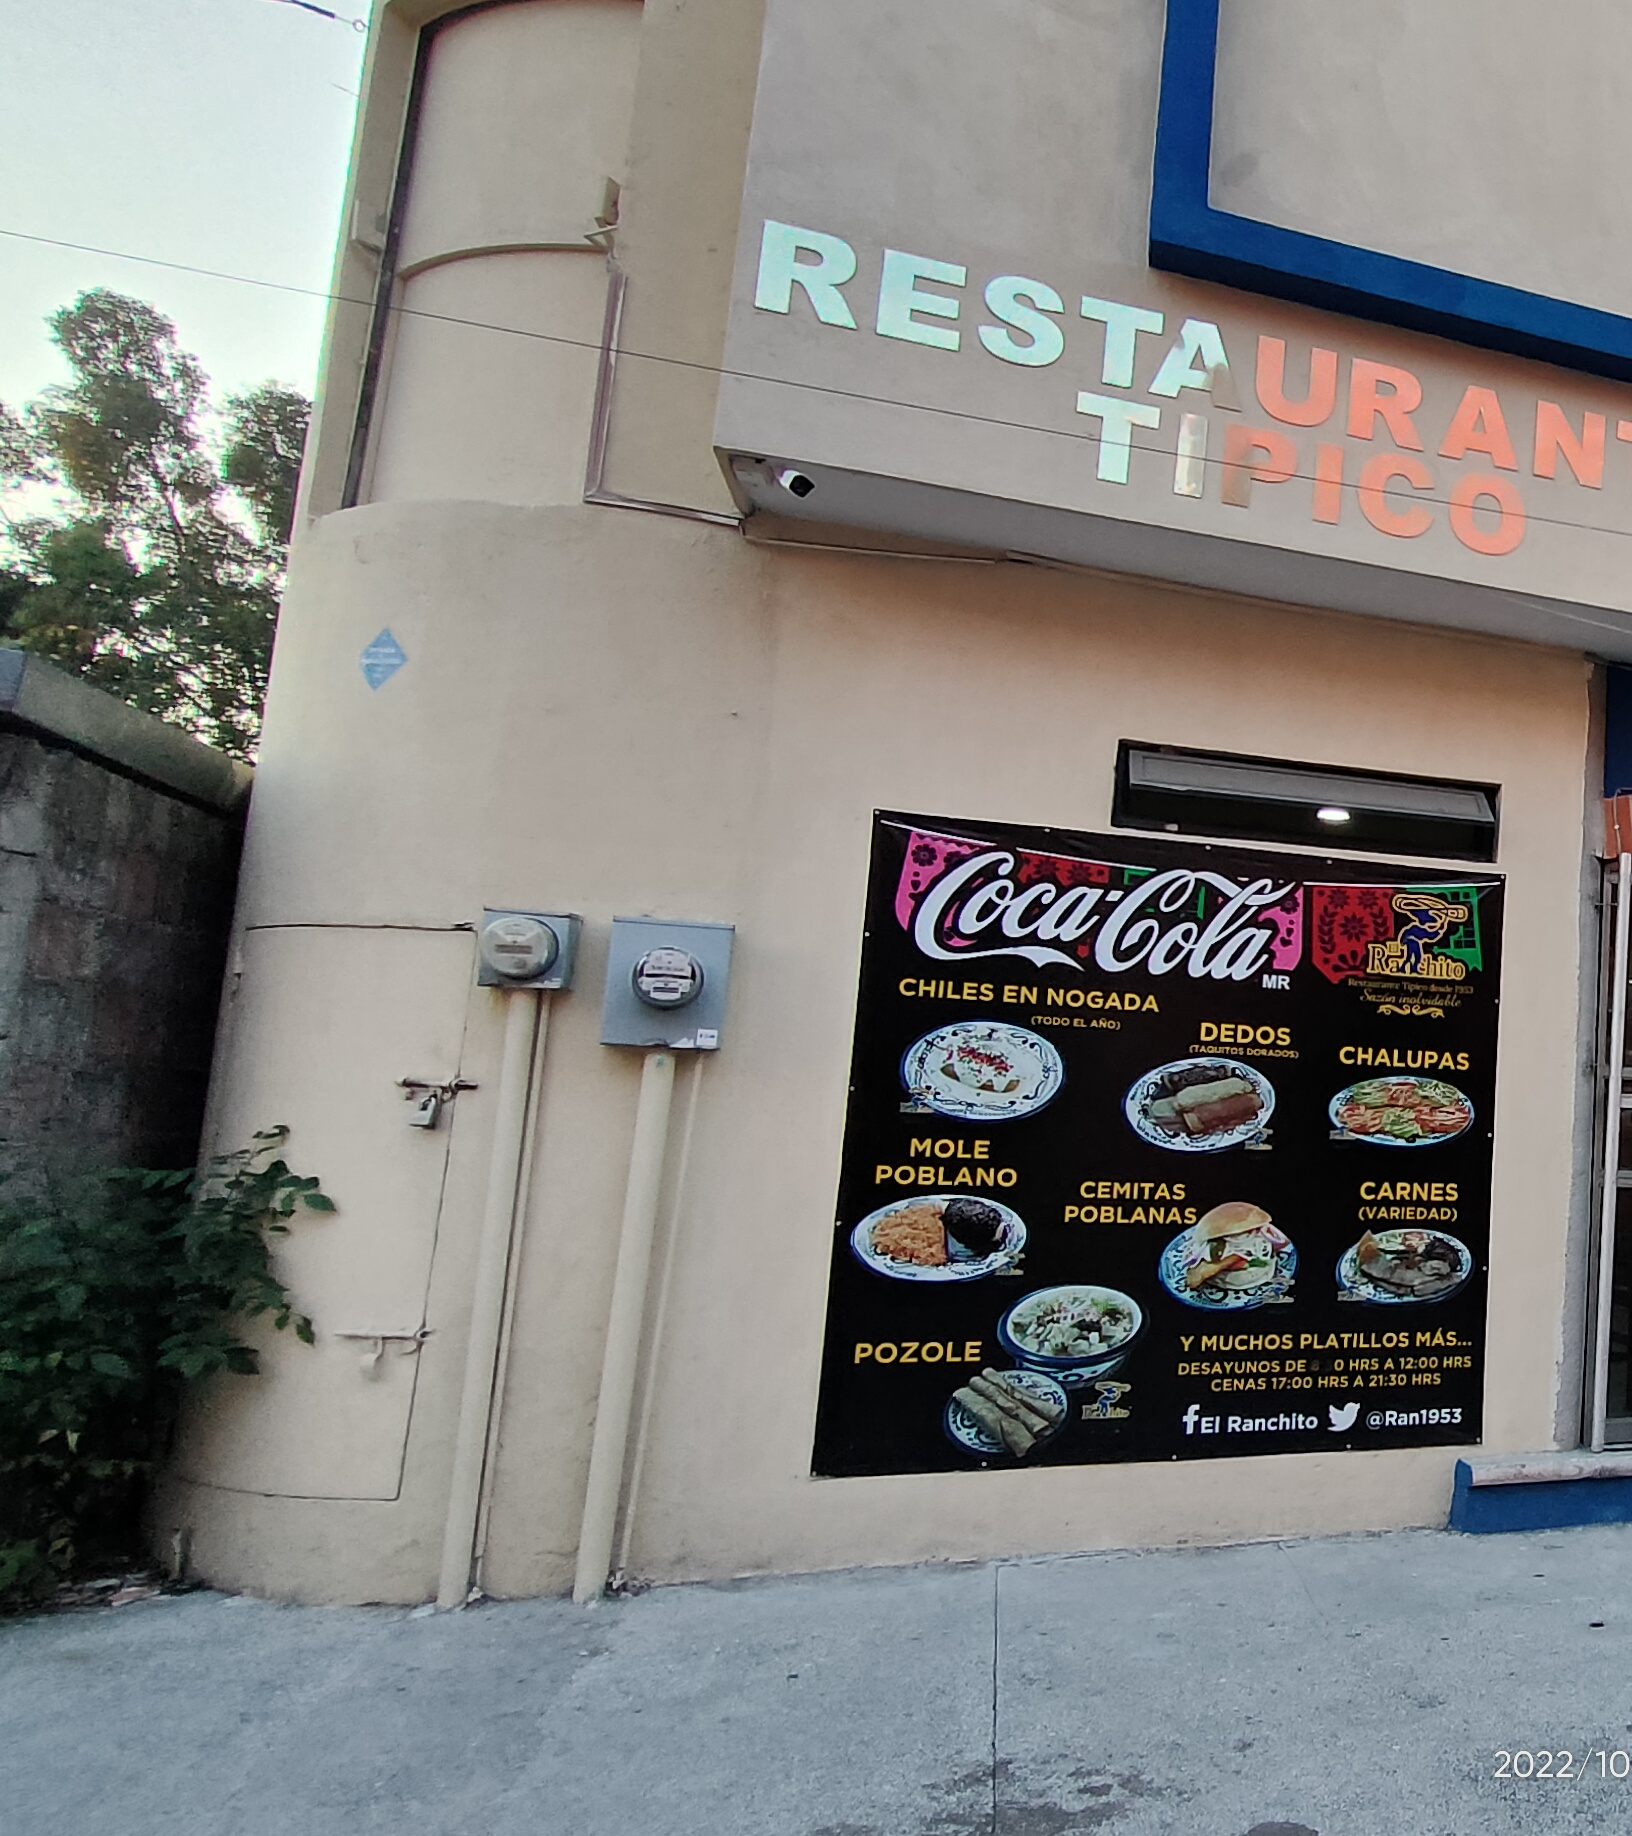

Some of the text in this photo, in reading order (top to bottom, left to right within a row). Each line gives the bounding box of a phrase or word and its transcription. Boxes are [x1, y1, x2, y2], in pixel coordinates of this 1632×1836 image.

[1076, 390, 1527, 556] TIPICO
[914, 849, 1298, 982] Coca-Cola
[1367, 943, 1466, 981] Rachito
[1262, 974, 1291, 991] MR
[899, 978, 1160, 1014] CHILES EN NOGADA
[1031, 1014, 1121, 1031] (TODO EL AÑO)
[1199, 1022, 1292, 1046] DEDOS
[1188, 1043, 1299, 1060] (TAQUITOS DORADOS)
[1338, 1046, 1470, 1071] CHALUPAS
[909, 1138, 990, 1160] MOLE
[875, 1164, 1018, 1188] POBLANO
[1079, 1181, 1187, 1202] CEMITAS
[1359, 1181, 1458, 1203] CARNES
[1064, 1203, 1197, 1226] POBLANAS
[1358, 1205, 1458, 1222] (VARIEDAD)
[1180, 1326, 1473, 1352] Y MUCHOS PLATILLOS MÁS...
[854, 1341, 983, 1364] POZOLE
[1178, 1359, 1280, 1375] DESAYUNOS
[1285, 1360, 1307, 1372] DE
[1349, 1358, 1379, 1372] HRS
[1384, 1358, 1395, 1371] A
[1399, 1357, 1439, 1370] 12:00
[1443, 1356, 1472, 1369] HRS
[1211, 1373, 1442, 1392] CENAS 17:00 HRS A 21:30 HRS
[1200, 1408, 1463, 1434] El Ranchito @Ran1953
